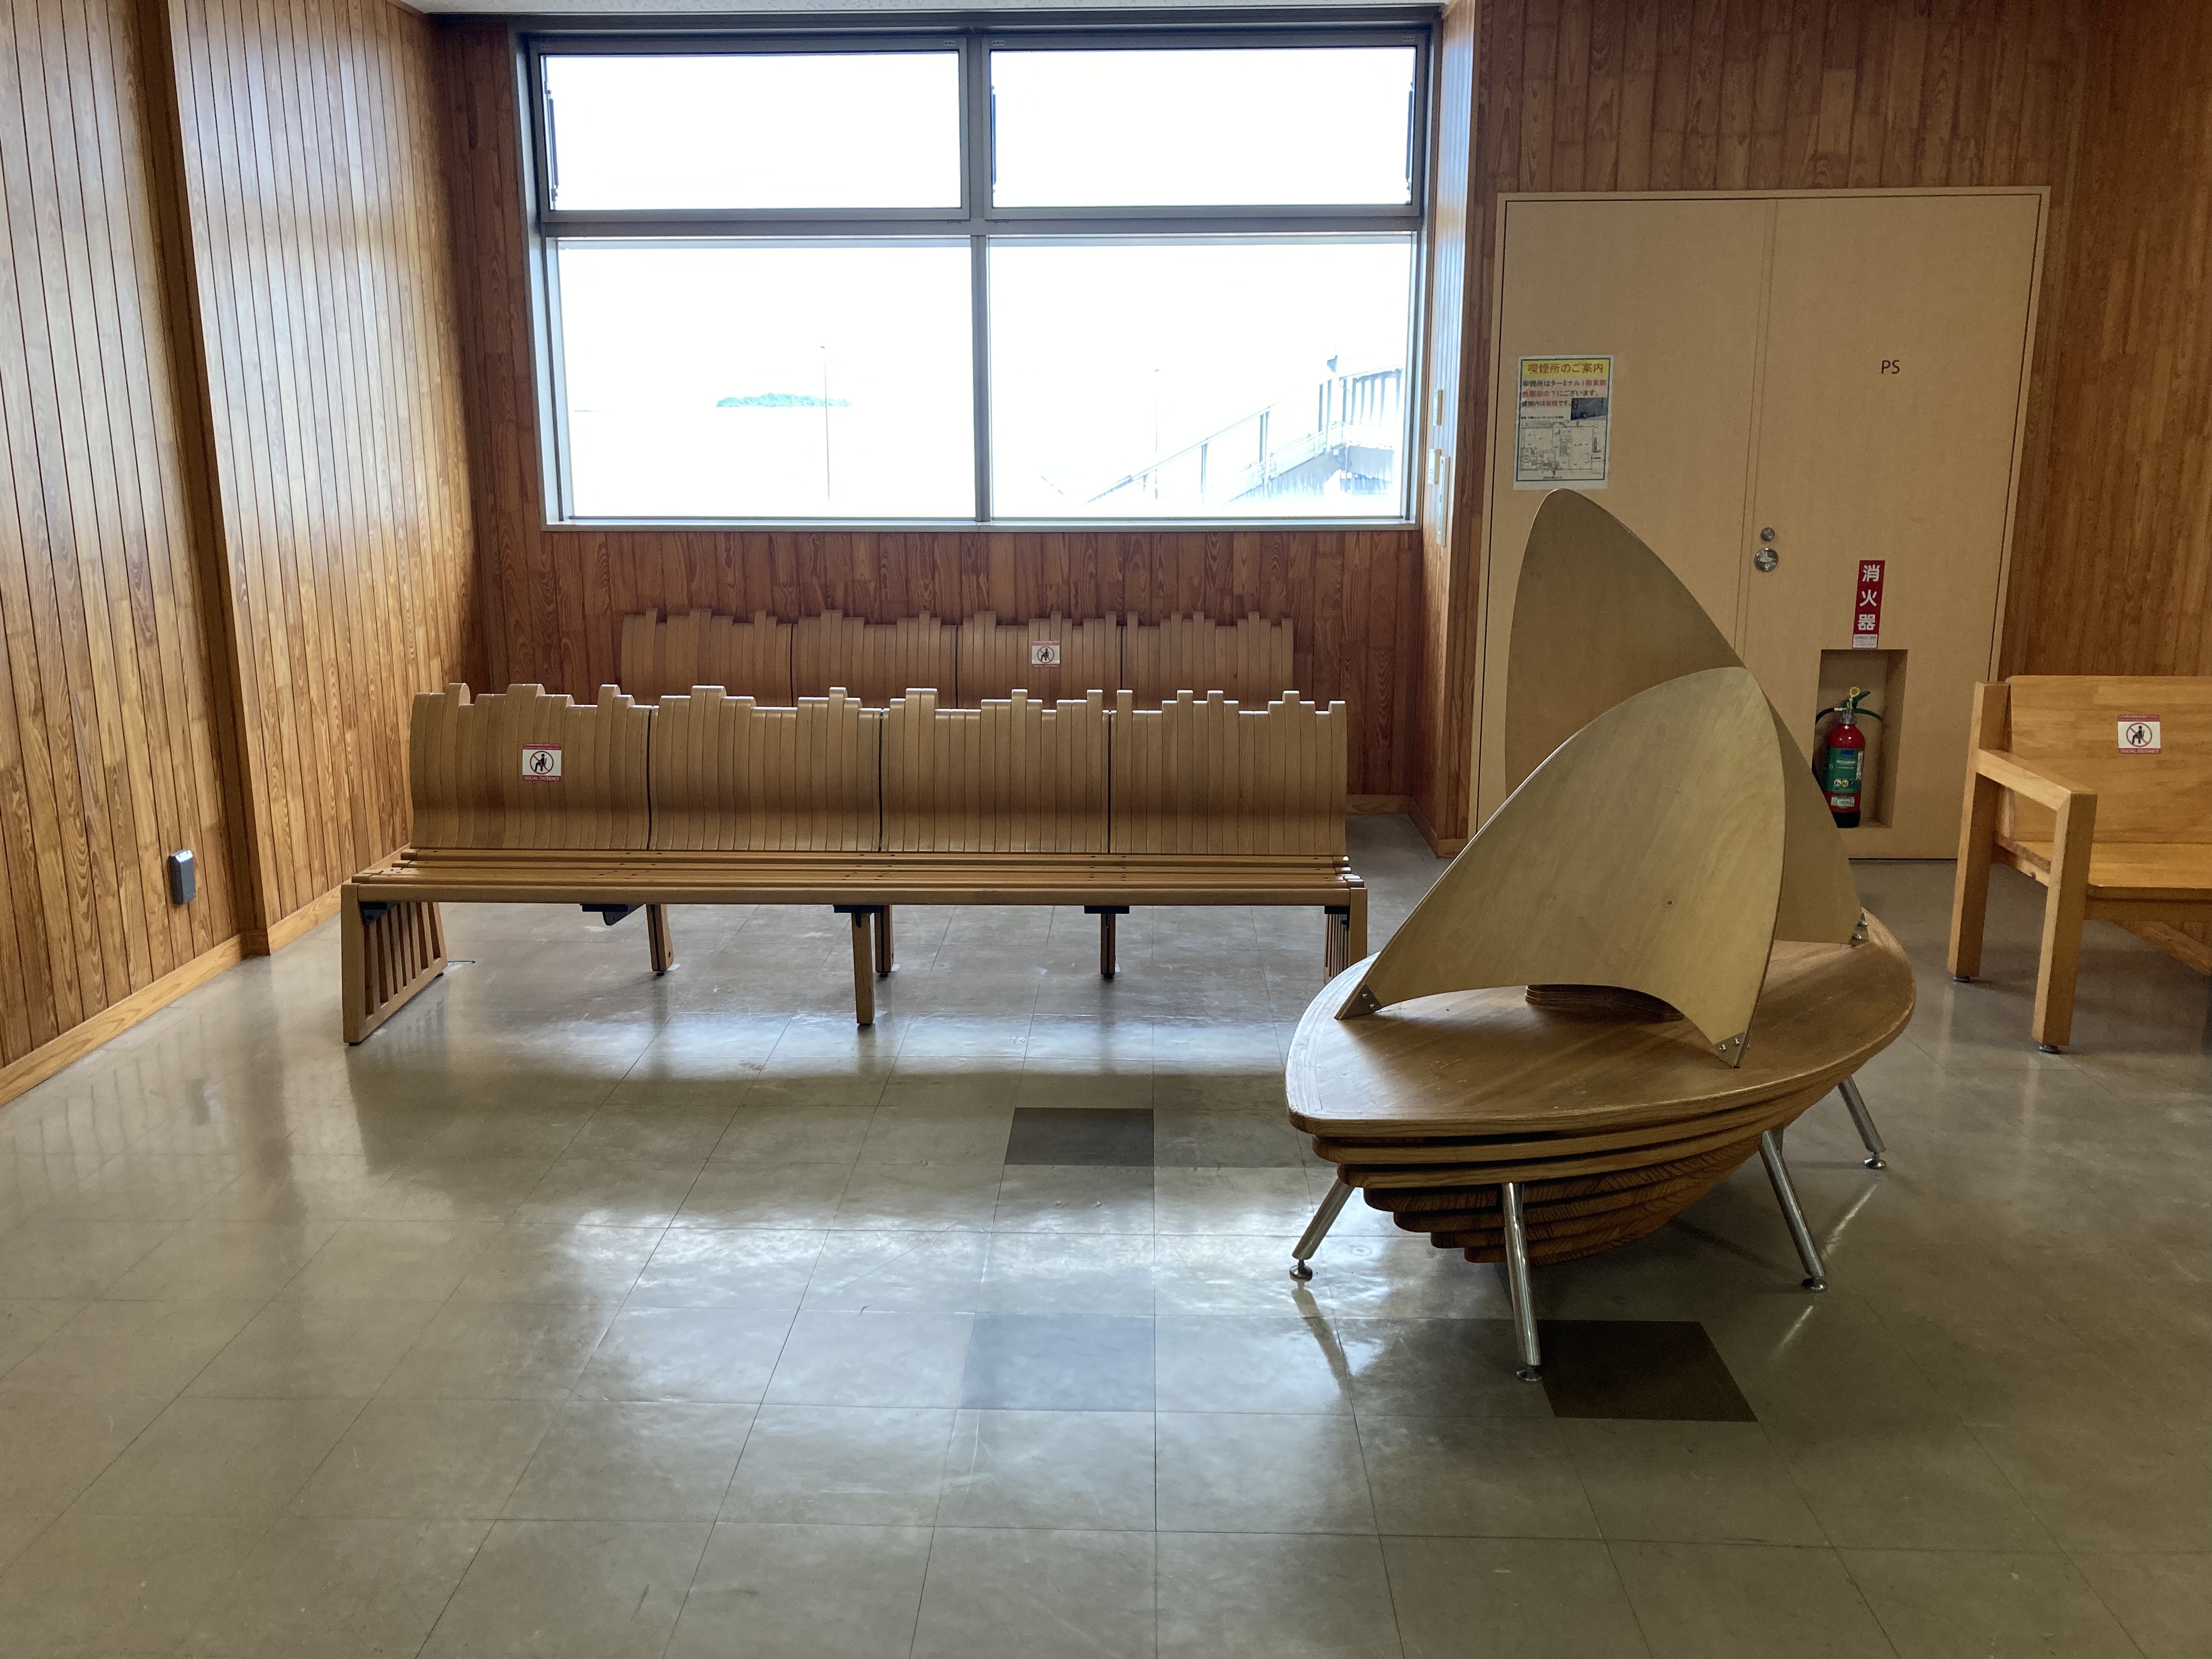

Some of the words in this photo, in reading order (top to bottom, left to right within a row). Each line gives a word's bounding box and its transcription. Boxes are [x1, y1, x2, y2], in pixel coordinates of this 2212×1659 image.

[1527, 363, 1603, 374] 喫煙所のご案内
[1881, 360, 1900, 374] PS
[1858, 564, 1880, 631] 消火器
